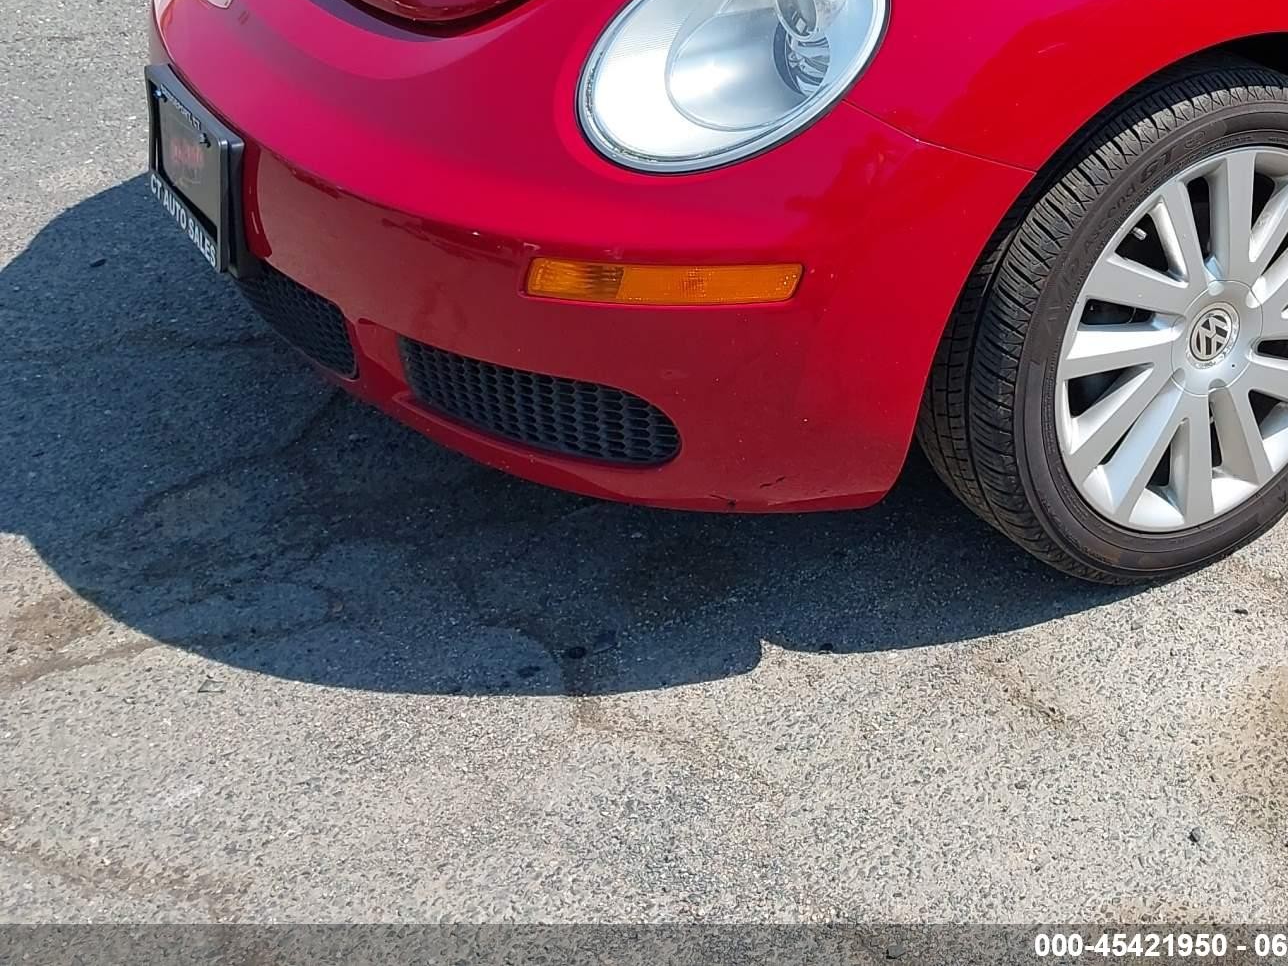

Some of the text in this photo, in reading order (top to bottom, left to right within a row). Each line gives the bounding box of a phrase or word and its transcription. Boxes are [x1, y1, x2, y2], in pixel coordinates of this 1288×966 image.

[151, 173, 216, 268] CT AUTO SALES
